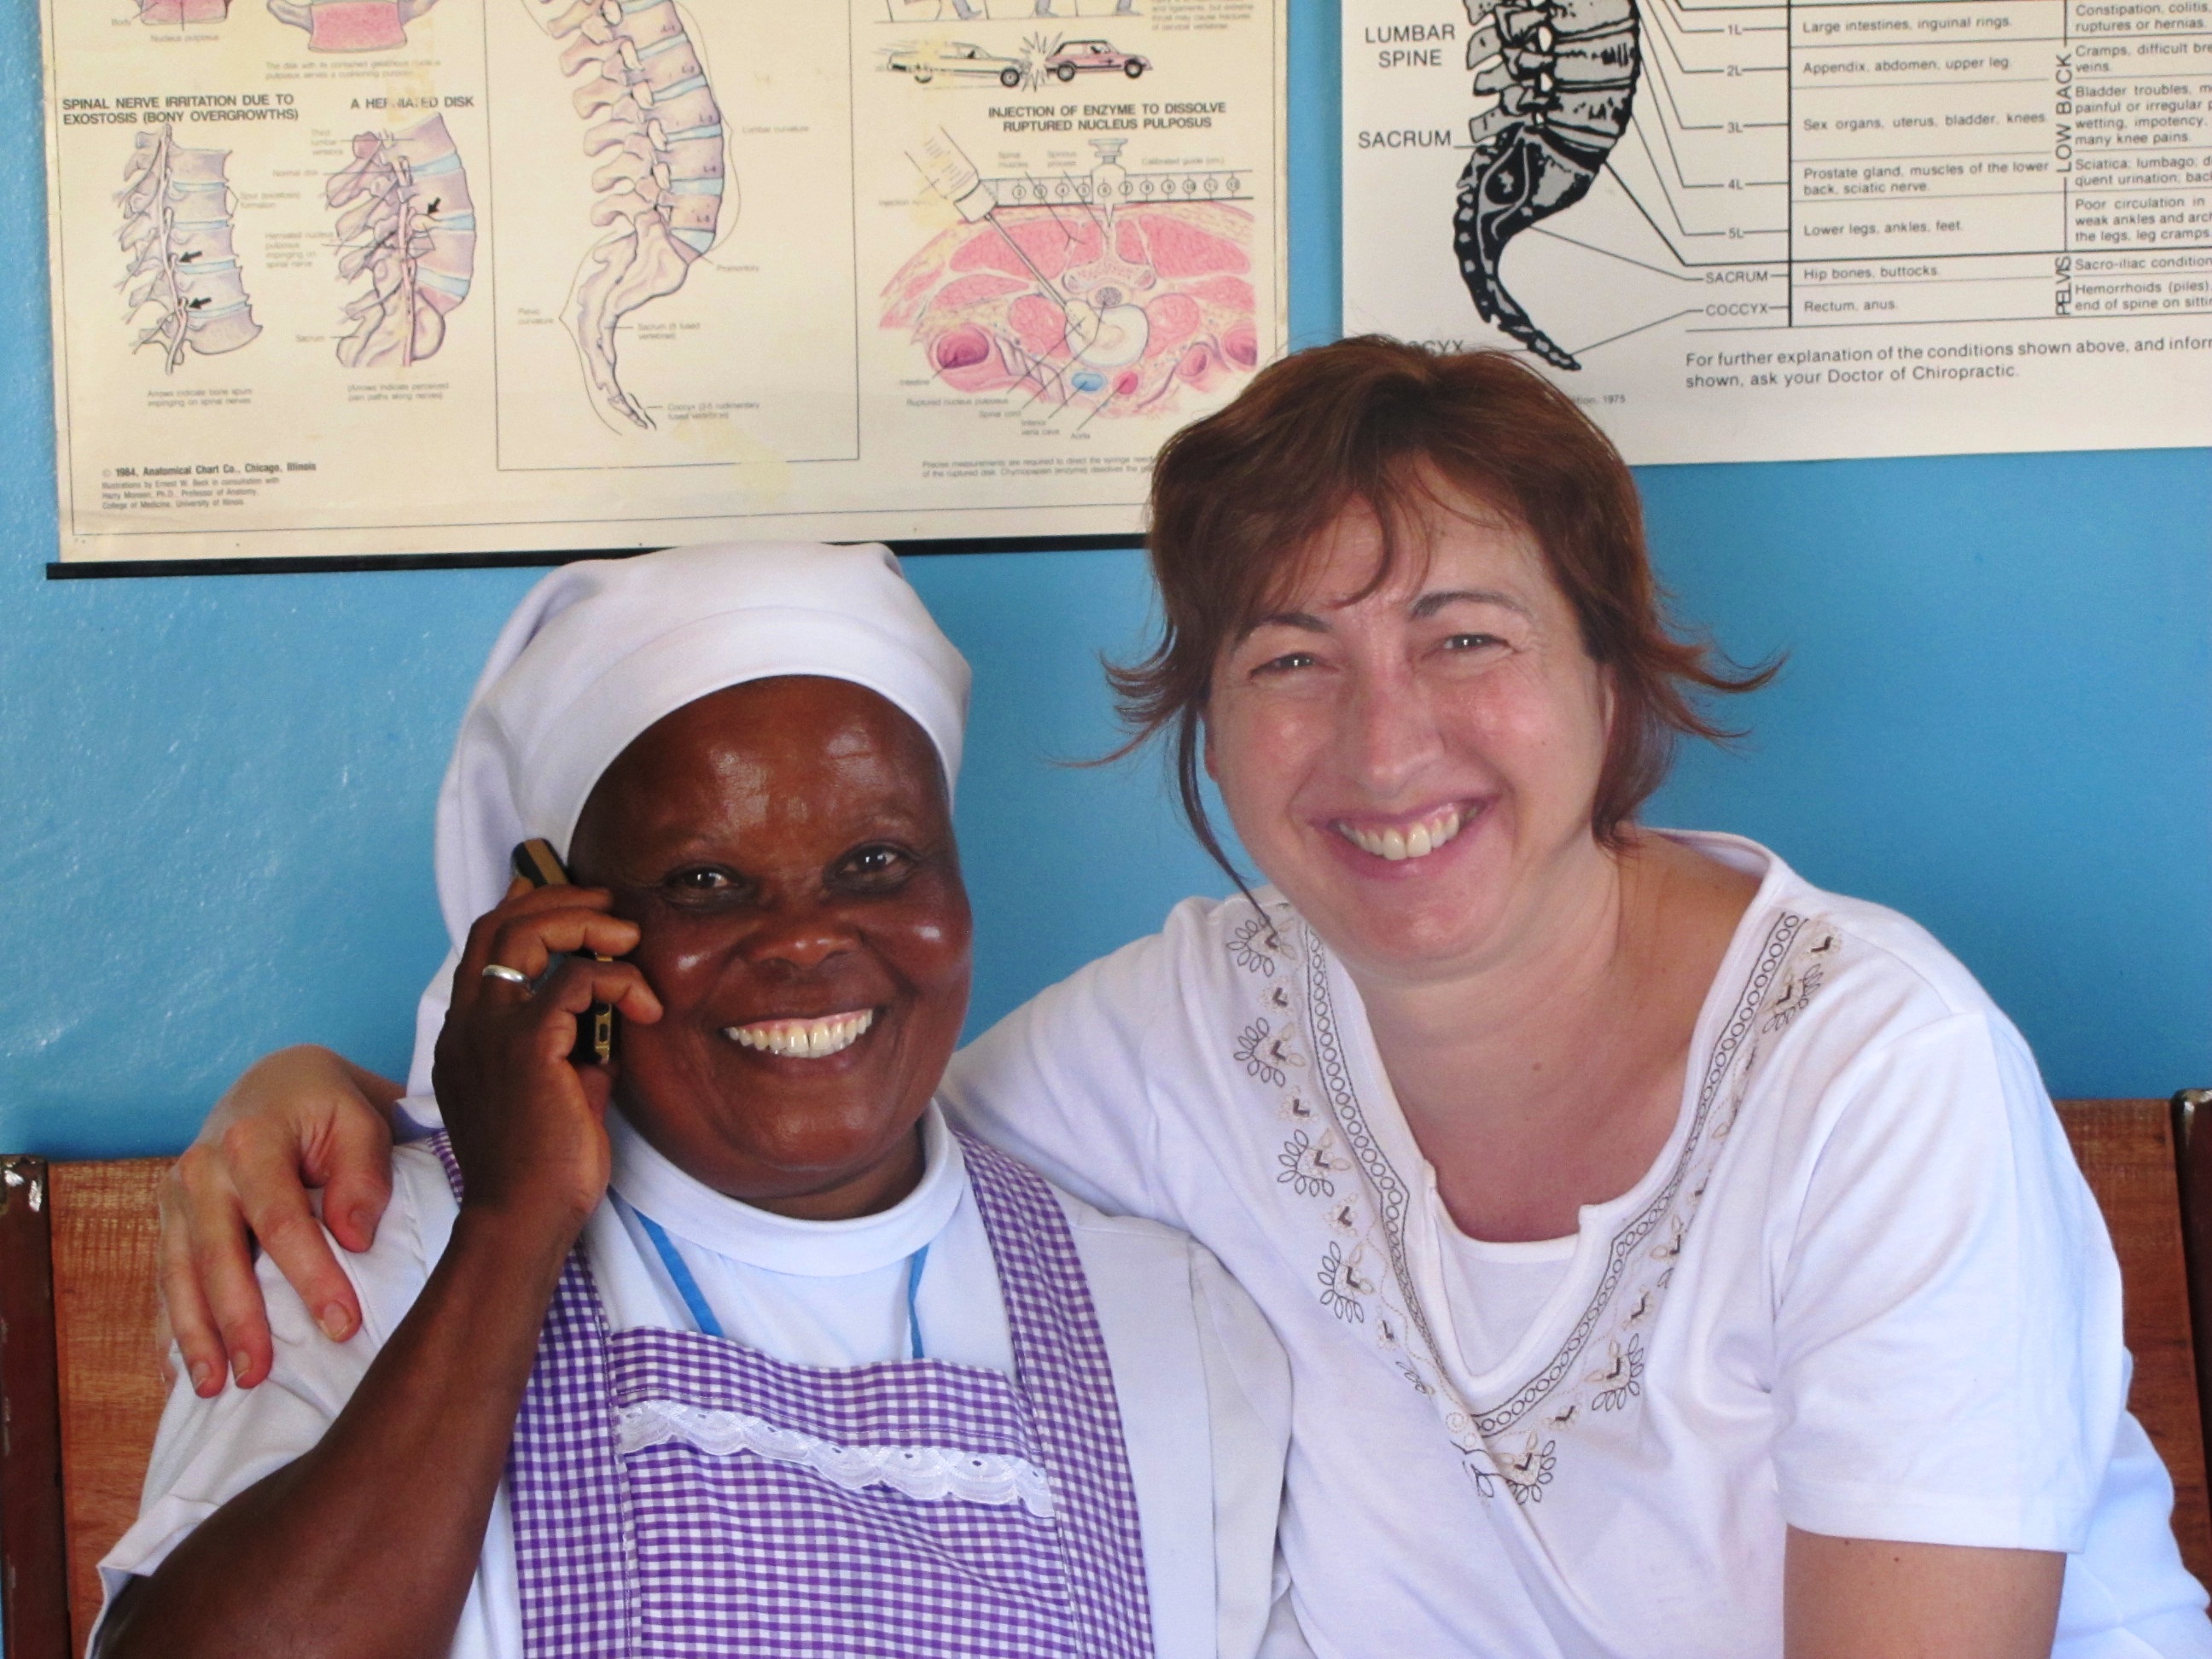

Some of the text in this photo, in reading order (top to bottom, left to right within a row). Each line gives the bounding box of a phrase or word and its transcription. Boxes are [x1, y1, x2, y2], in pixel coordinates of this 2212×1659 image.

[1727, 24, 1743, 36] 1L
[1803, 22, 1840, 35] Large
[1846, 20, 1912, 32] intestines,
[1918, 17, 1970, 29] inguinal
[2075, 20, 2131, 32] ruptures
[2136, 20, 2149, 30] or
[1365, 24, 1456, 44] LUMBAR
[2075, 45, 2131, 58] Cramps,
[2137, 44, 2187, 55] difficult
[1378, 49, 1442, 68] SPINE
[1727, 66, 1743, 77] 2L
[1803, 61, 1870, 75] Appendix,
[1875, 60, 1941, 72] abdomen,
[1946, 58, 1983, 70] upper
[2075, 85, 2127, 97] Bladder
[2134, 84, 2192, 96] troubles,
[63, 94, 294, 110] SPINAL NERVE IRRITATION DUE TO
[351, 99, 360, 109] A
[445, 96, 474, 108] DISK
[2075, 102, 2121, 115] painful
[2126, 102, 2140, 112] or
[2146, 100, 2202, 113] irregular
[63, 108, 298, 125] EXOSTOSIS (BONY OVERGROWTHS)
[988, 102, 1225, 118] INJECTION OF ENZYME TO DISSOLVE
[2056, 53, 2072, 173] LOW BACK
[1004, 116, 1212, 131] RUPTURED NUCLEUS PULPOSUS
[1727, 122, 1743, 133] 3L
[1803, 119, 1827, 130] Sex
[1836, 119, 1884, 131] organs,
[1893, 116, 1938, 127] uterus,
[2075, 116, 2208, 131] wetting, impotency,
[1359, 130, 1451, 148] SACRUM
[2075, 135, 2111, 147] many
[2116, 133, 2148, 143] knee
[1804, 161, 2049, 179] Prostate gland, muscles of the lower
[1728, 180, 1743, 190] 4L
[2075, 175, 2113, 188] quent
[1804, 183, 1839, 195] back,
[1843, 183, 1885, 194] sciatic
[2075, 197, 2205, 210] Poor circulation in
[2075, 216, 2108, 226] weak
[2113, 214, 2155, 224] ankles
[2160, 213, 2185, 224] and
[1728, 228, 1744, 239] 5L
[1804, 224, 1844, 236] Lower
[1849, 223, 1879, 236] legs,
[1884, 221, 1930, 233] ankles,
[2075, 231, 2096, 242] the
[2100, 230, 2130, 243] legs,
[2137, 230, 2156, 242] leg
[2075, 259, 2146, 271] Sacro-iliac
[1706, 271, 1768, 283] SACRUM
[1804, 269, 1826, 281] Hip
[1832, 268, 1875, 279] bones,
[2056, 256, 2072, 316] PELVIS
[2075, 282, 2162, 295] Hemorrhoids
[1706, 304, 1768, 317] COCCYX
[1804, 300, 1858, 312] Rectum,
[2075, 300, 2100, 311] end
[2104, 299, 2118, 310] of
[2122, 300, 2159, 311] spine
[2163, 299, 2180, 308] on
[1686, 352, 1713, 367] For
[1718, 352, 1771, 366] further
[1778, 349, 1872, 365] explanation
[1877, 346, 1893, 361] of
[1898, 346, 1923, 359] the
[1927, 343, 2014, 358] conditions
[2018, 341, 2071, 356] shown
[2075, 340, 2129, 354] above,
[2134, 337, 2164, 352] and
[1686, 364, 2018, 388] shown, ask your Doctor of Chiropractic.
[143, 465, 192, 476] Anatomical
[195, 464, 219, 474] Chart
[287, 462, 317, 472] Illinois
